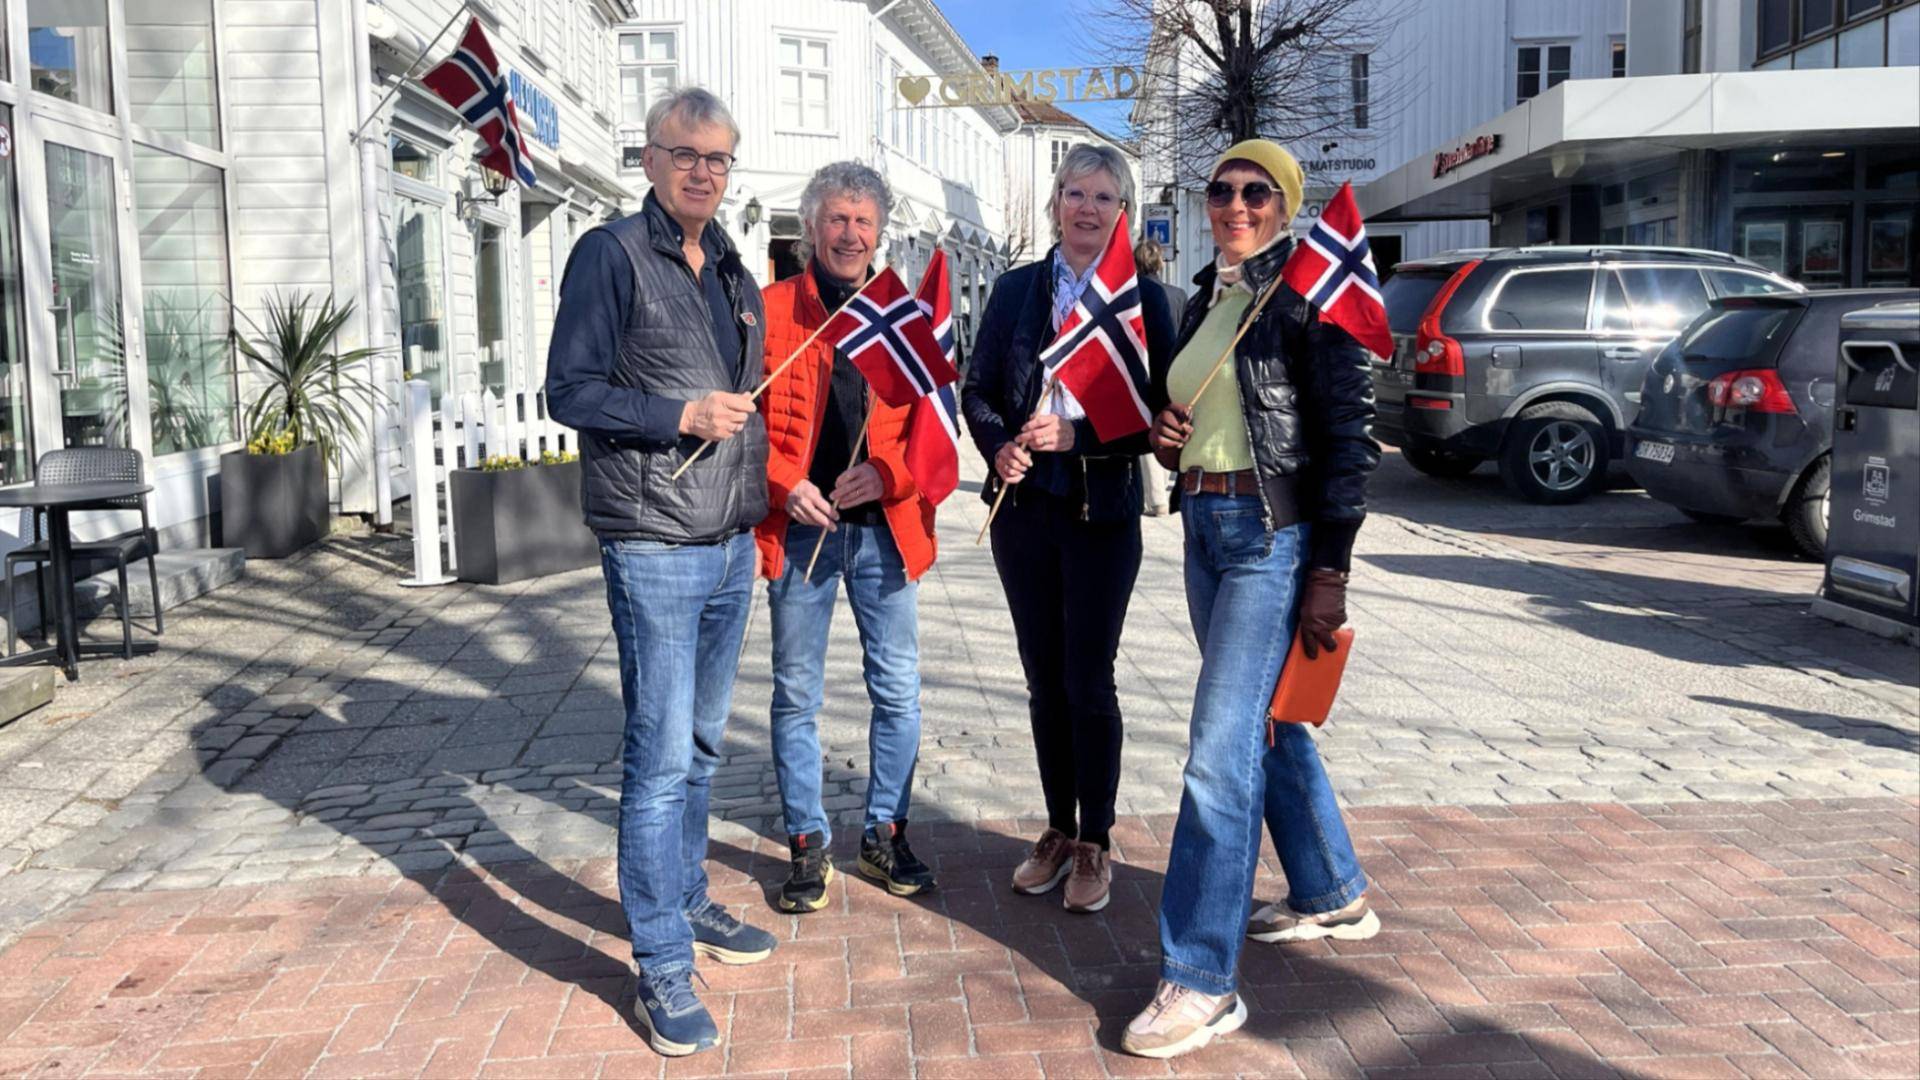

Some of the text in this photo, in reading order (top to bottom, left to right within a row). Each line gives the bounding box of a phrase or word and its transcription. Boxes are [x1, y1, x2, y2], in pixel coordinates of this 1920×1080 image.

[940, 66, 1139, 105] GRIMSTAD
[1310, 158, 1376, 172] MATSTUDIO
[1853, 508, 1896, 528] Grimstad
